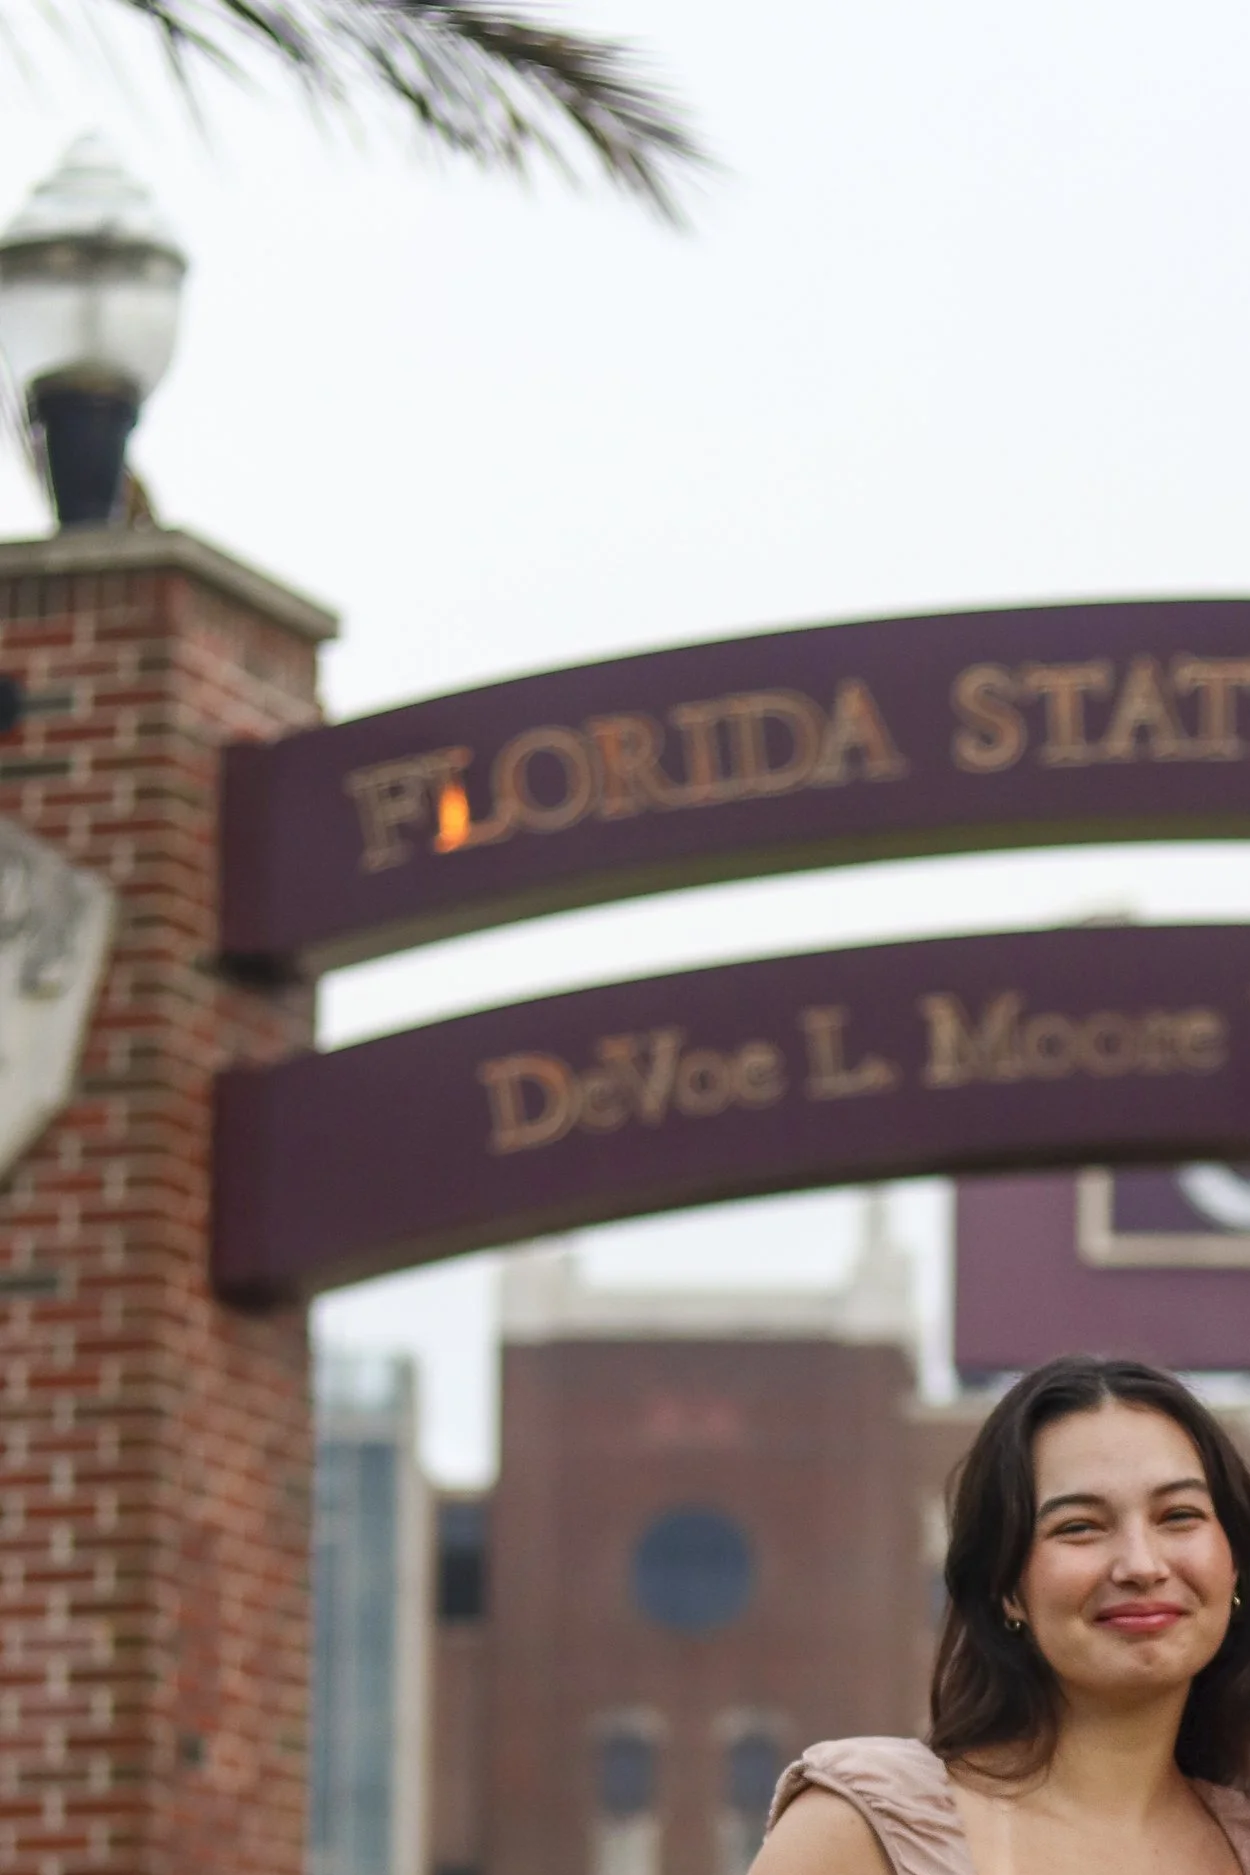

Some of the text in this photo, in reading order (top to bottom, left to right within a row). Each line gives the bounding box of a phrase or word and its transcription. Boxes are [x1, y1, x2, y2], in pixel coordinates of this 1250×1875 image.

[344, 676, 908, 874] FLORIDA
[476, 1024, 787, 1157] DeVoe
[804, 1008, 899, 1102] L.
[917, 990, 1227, 1091] Moore
